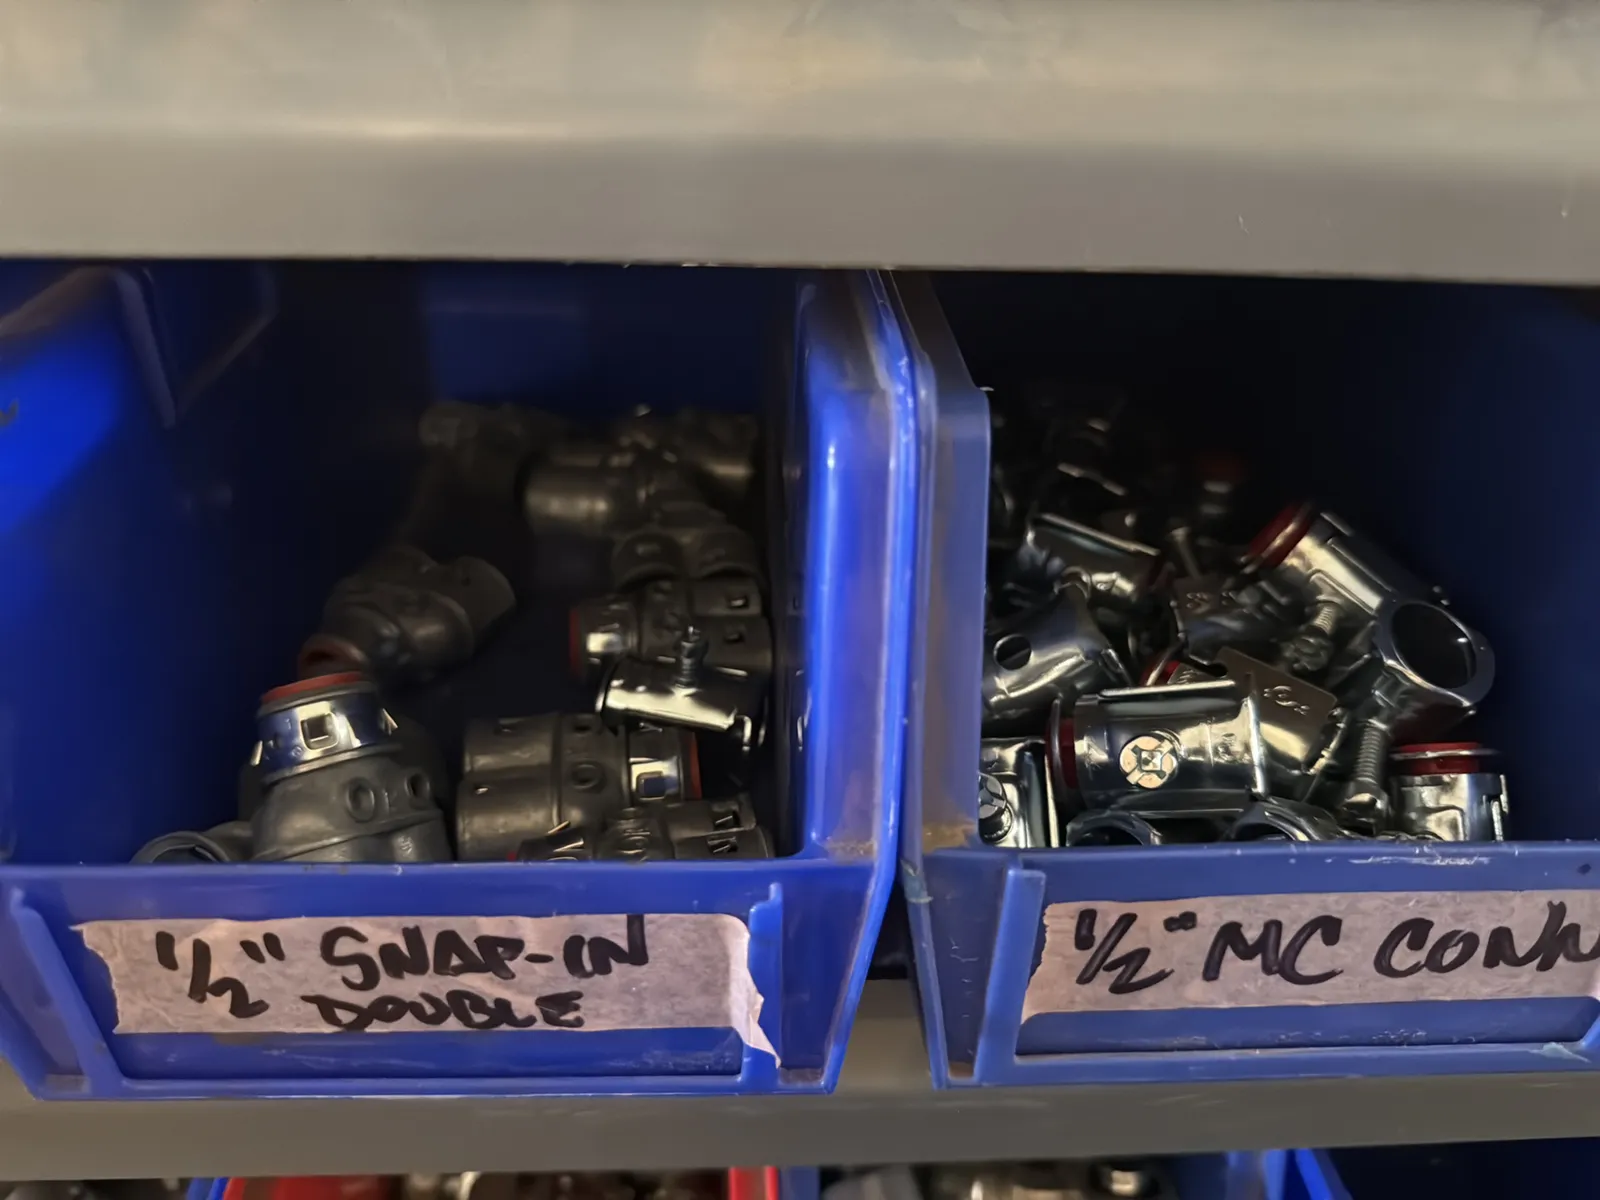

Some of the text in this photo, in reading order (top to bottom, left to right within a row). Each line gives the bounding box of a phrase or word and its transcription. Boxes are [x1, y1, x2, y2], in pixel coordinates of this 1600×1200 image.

[319, 914, 649, 992] SNAP-IN
[1203, 915, 1344, 986] MC
[301, 989, 584, 1034] DOUBLE
